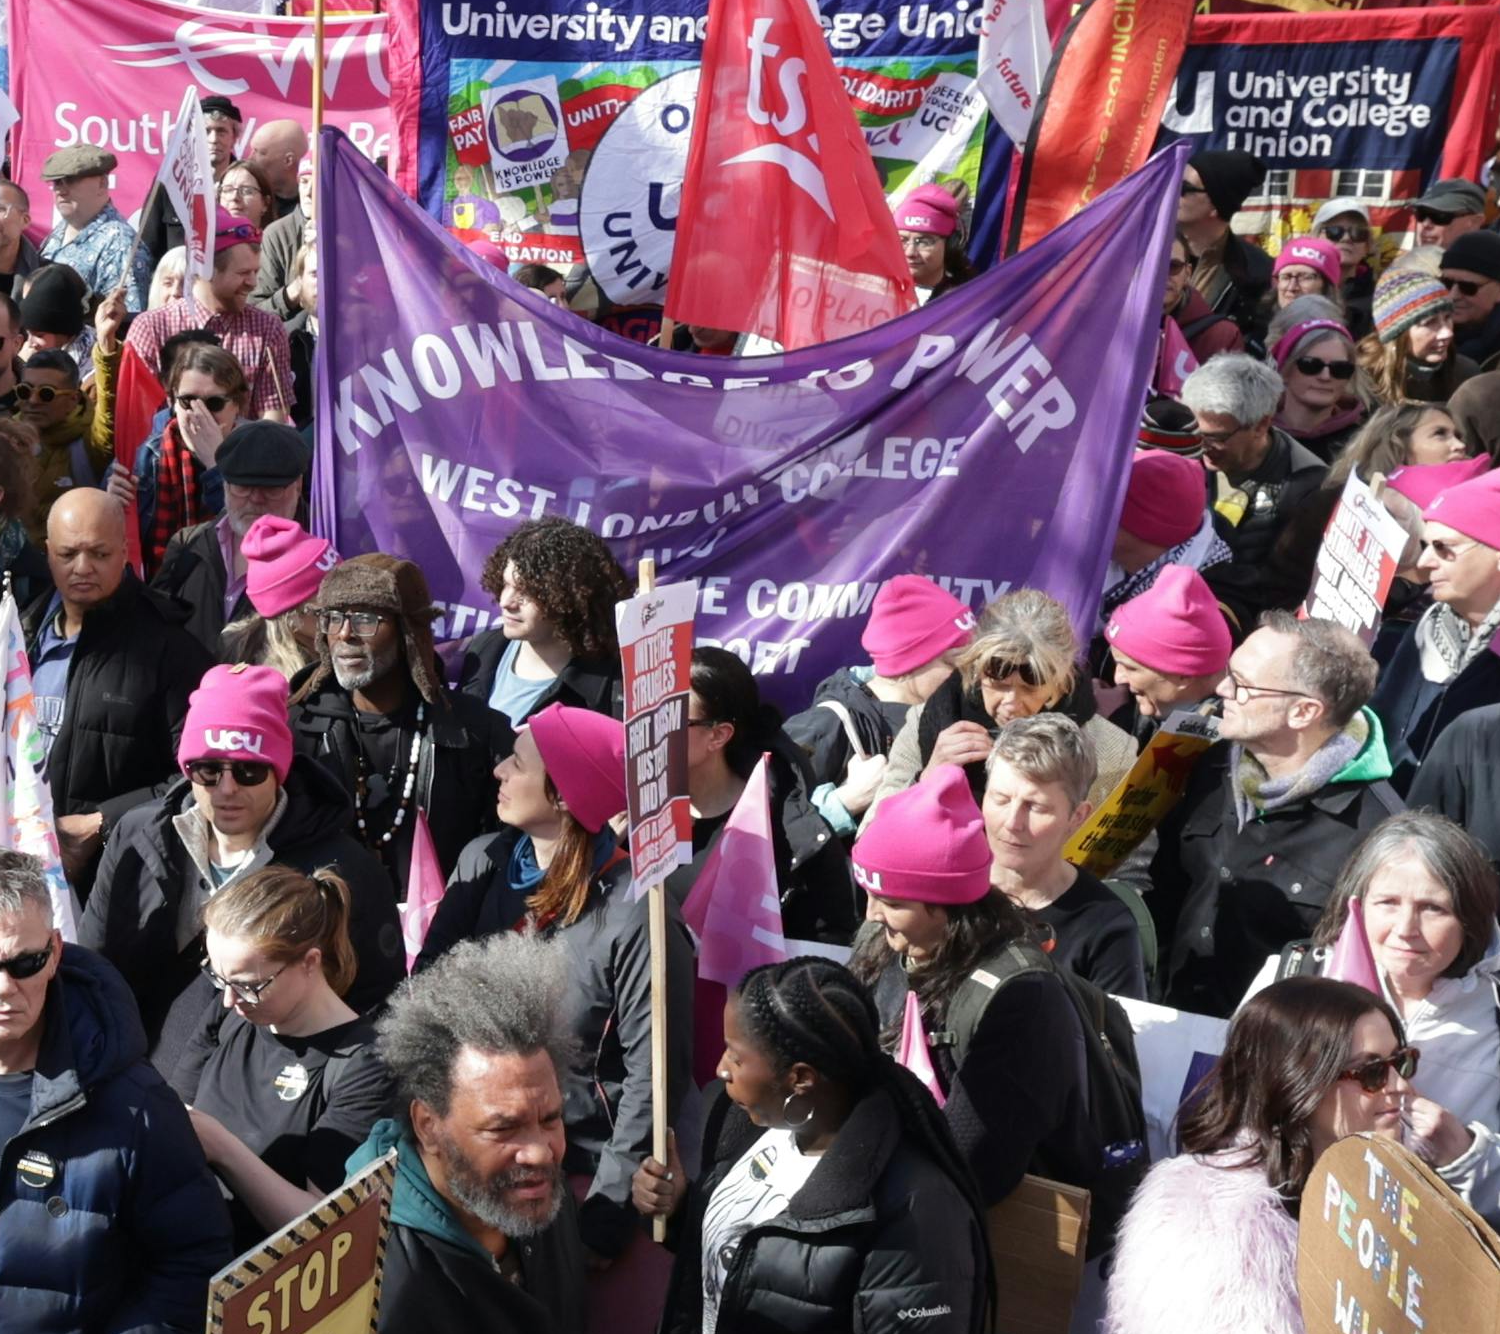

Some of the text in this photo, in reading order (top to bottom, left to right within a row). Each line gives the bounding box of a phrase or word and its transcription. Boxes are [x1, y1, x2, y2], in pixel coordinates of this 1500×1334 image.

[440, 0, 646, 52] University
[930, 85, 981, 110] DEFEND
[996, 56, 1032, 110] future
[1228, 64, 1413, 106] University
[448, 109, 483, 137] FAIR
[1225, 96, 1432, 137] and College
[453, 125, 485, 154] PAY
[1225, 129, 1333, 158] Union
[494, 156, 561, 180] KNOWLEDGE
[501, 174, 513, 190] IS
[904, 215, 932, 227] UCU
[489, 231, 523, 246] END
[1291, 244, 1328, 265] UCU
[889, 315, 1080, 454] PWER
[417, 453, 558, 520] WEST
[204, 729, 265, 756] UCU
[1364, 1147, 1422, 1247] THE
[1322, 1170, 1425, 1331] PEOPLE
[907, 1304, 953, 1320] Columbia
